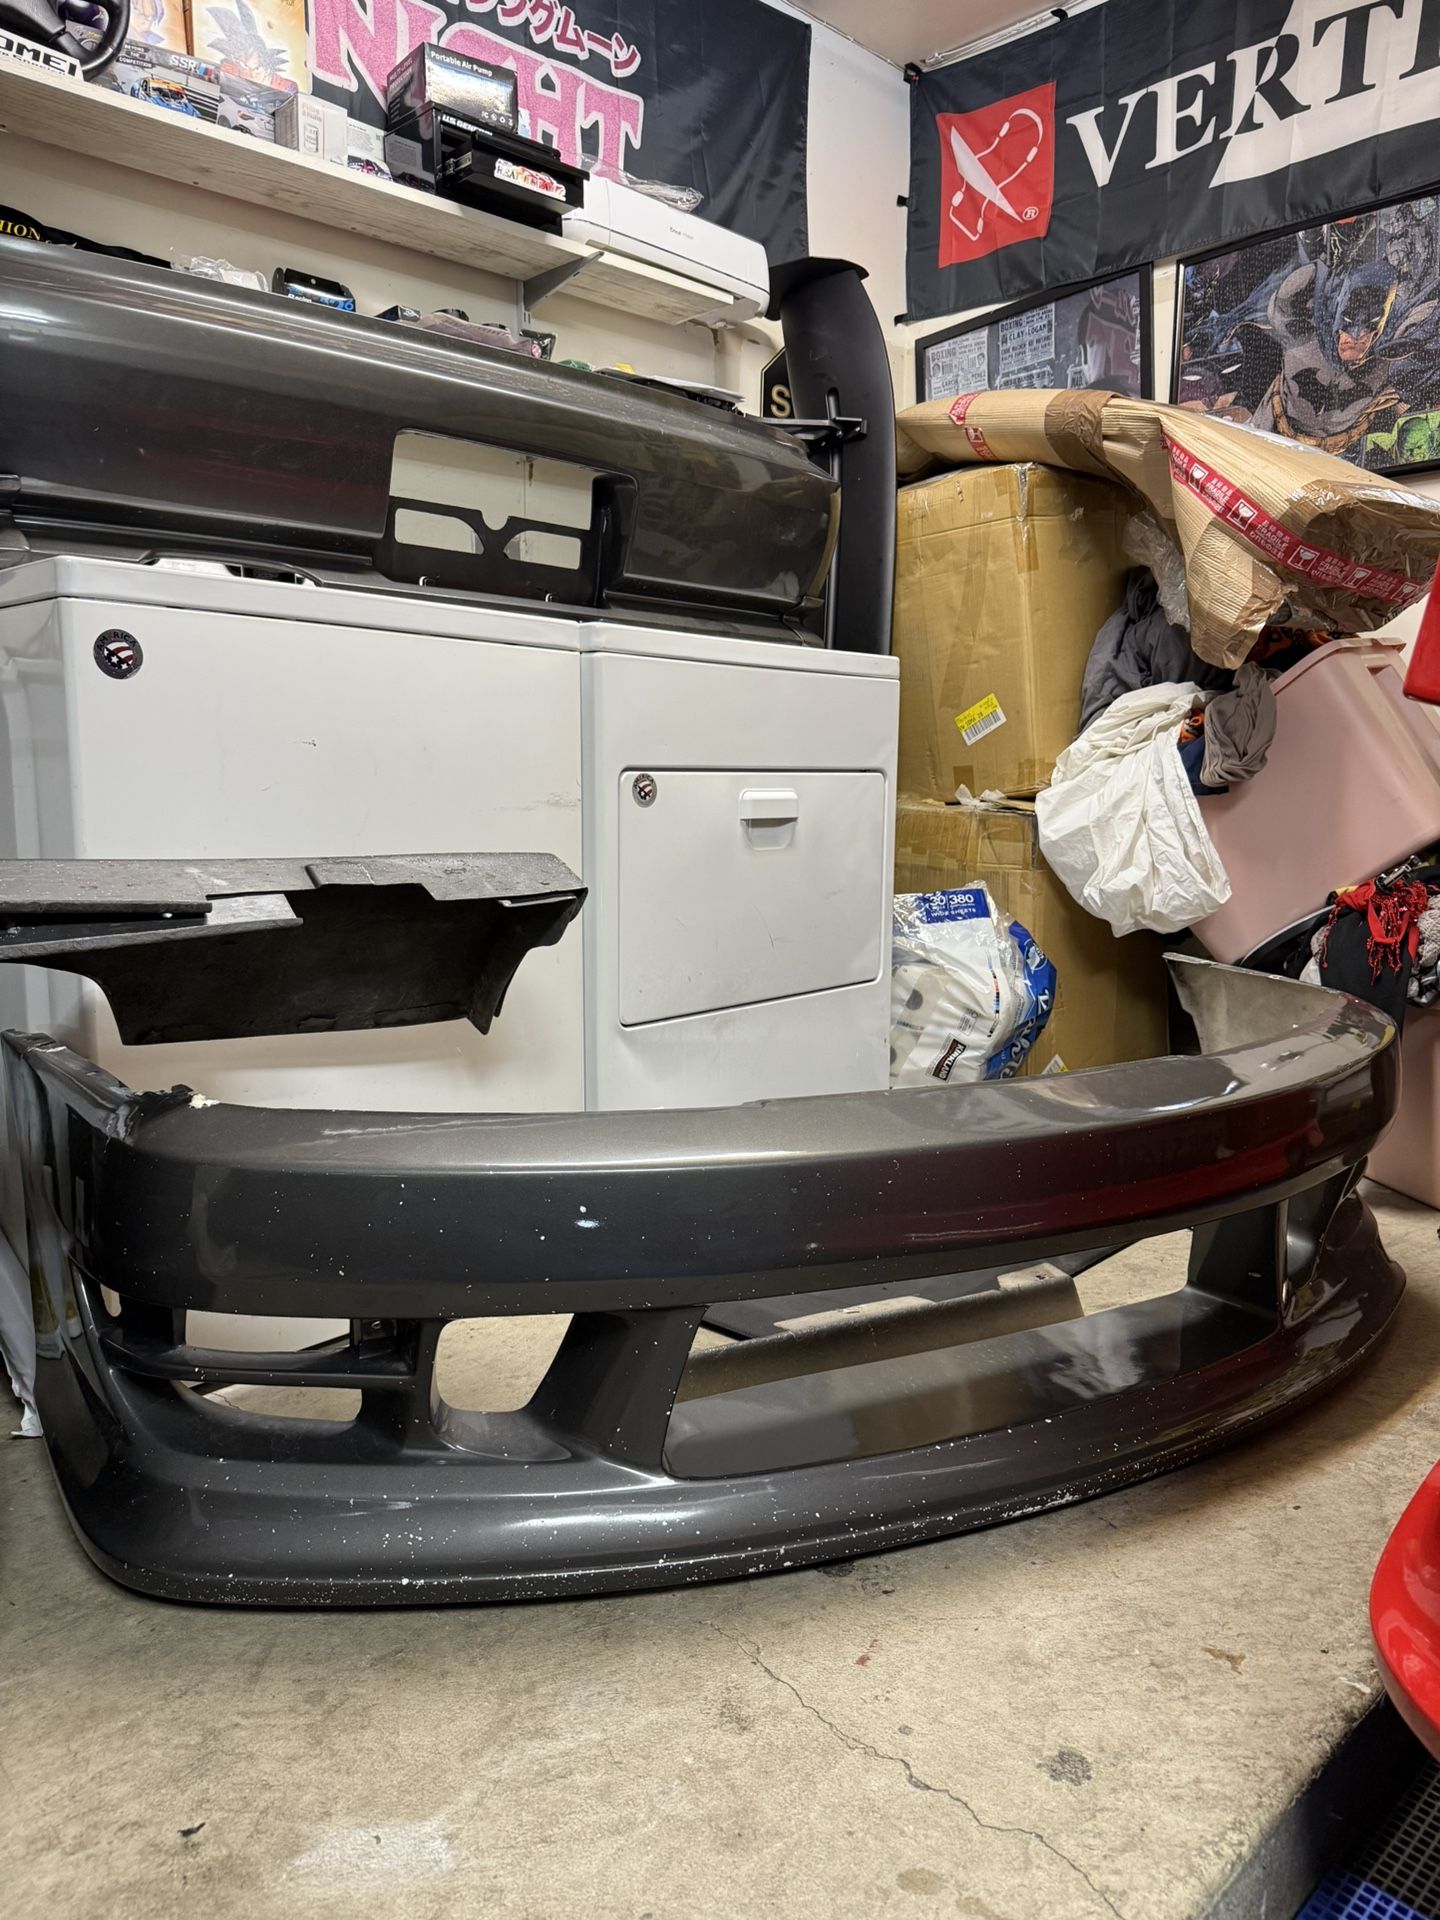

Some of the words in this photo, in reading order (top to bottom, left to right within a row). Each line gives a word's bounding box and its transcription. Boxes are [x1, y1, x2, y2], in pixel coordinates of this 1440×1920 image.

[169, 54, 197, 72] SSR
[430, 51, 461, 68] Portable
[462, 61, 472, 70] Air
[473, 64, 493, 77] Pump
[1257, 524, 1289, 548] FRAGILE
[929, 895, 946, 906] 30
[949, 894, 974, 905] 380
[939, 1042, 966, 1080] KIRKLAND
